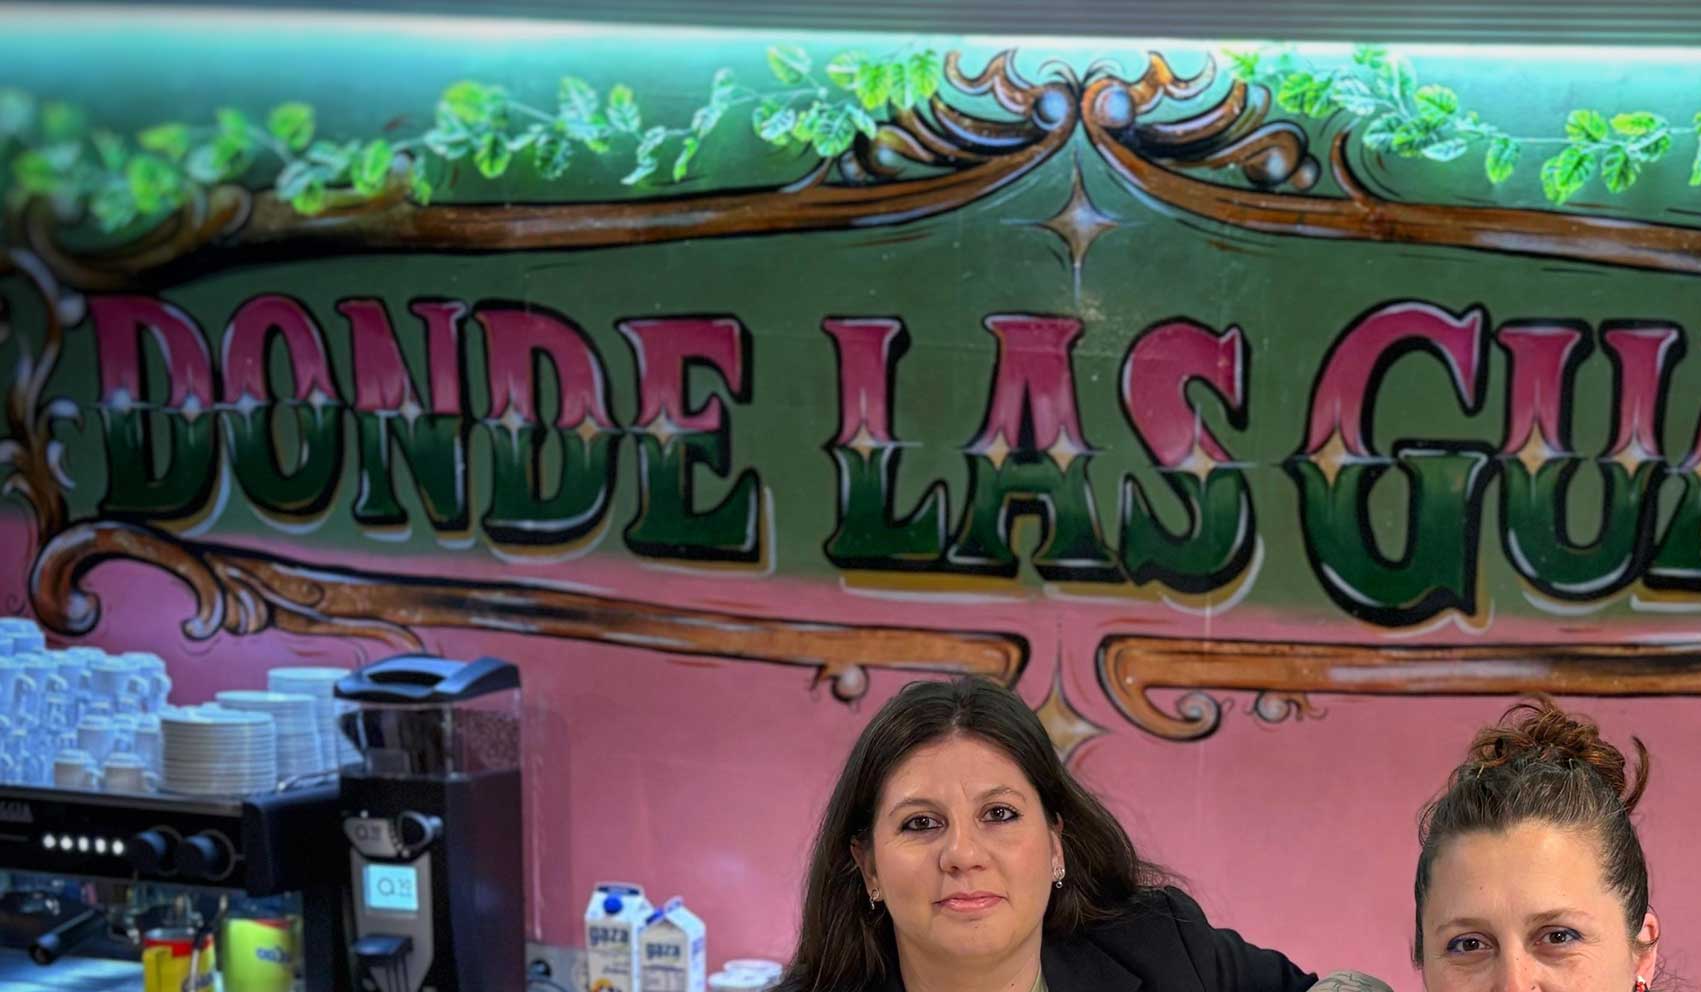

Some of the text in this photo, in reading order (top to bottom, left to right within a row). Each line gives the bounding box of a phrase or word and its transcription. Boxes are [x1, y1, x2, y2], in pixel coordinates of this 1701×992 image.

[86, 294, 774, 573] DONDE
[822, 314, 1260, 608] LAS
[588, 925, 629, 946] gaza
[647, 943, 680, 960] gaza
